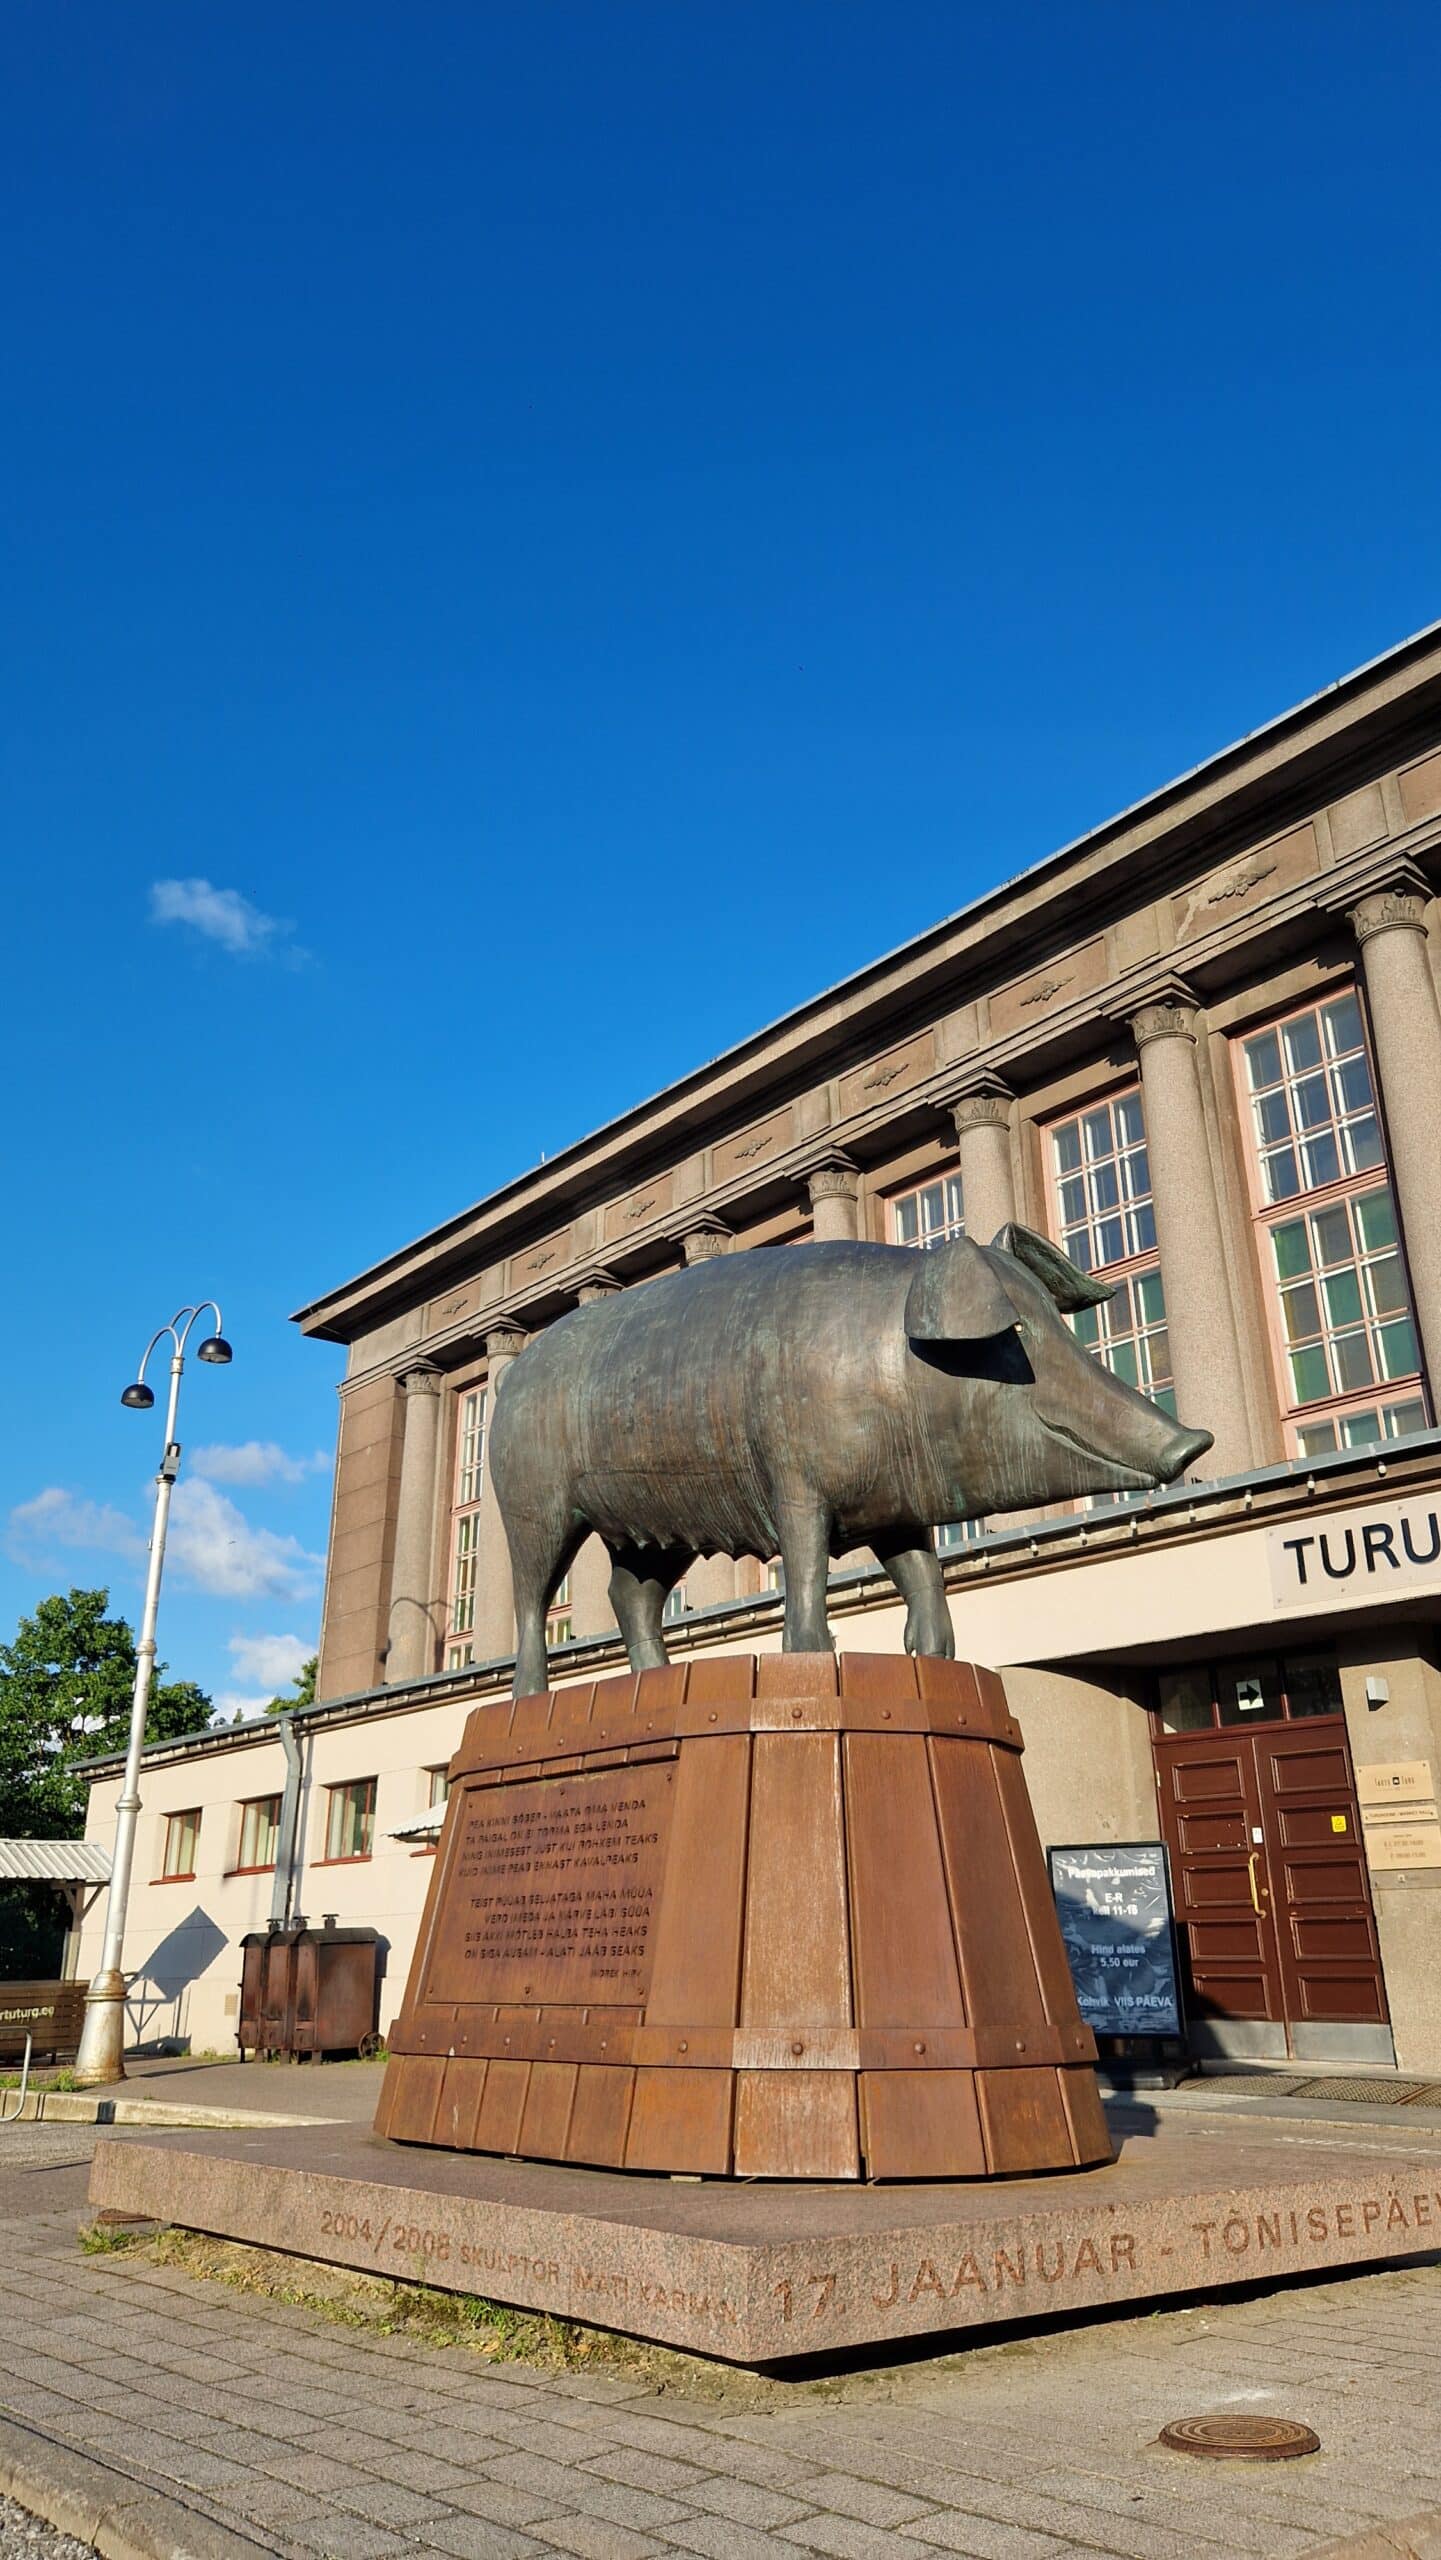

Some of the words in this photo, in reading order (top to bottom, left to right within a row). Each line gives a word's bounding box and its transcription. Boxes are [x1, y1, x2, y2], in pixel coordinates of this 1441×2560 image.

[1283, 1512, 1441, 1585] TURU
[625, 1833, 659, 1845] TEAKS
[320, 2209, 451, 2262] 2004/2008
[871, 2233, 1137, 2312] JAANUAR
[1192, 2189, 1441, 2260] TÕNISEPÄE
